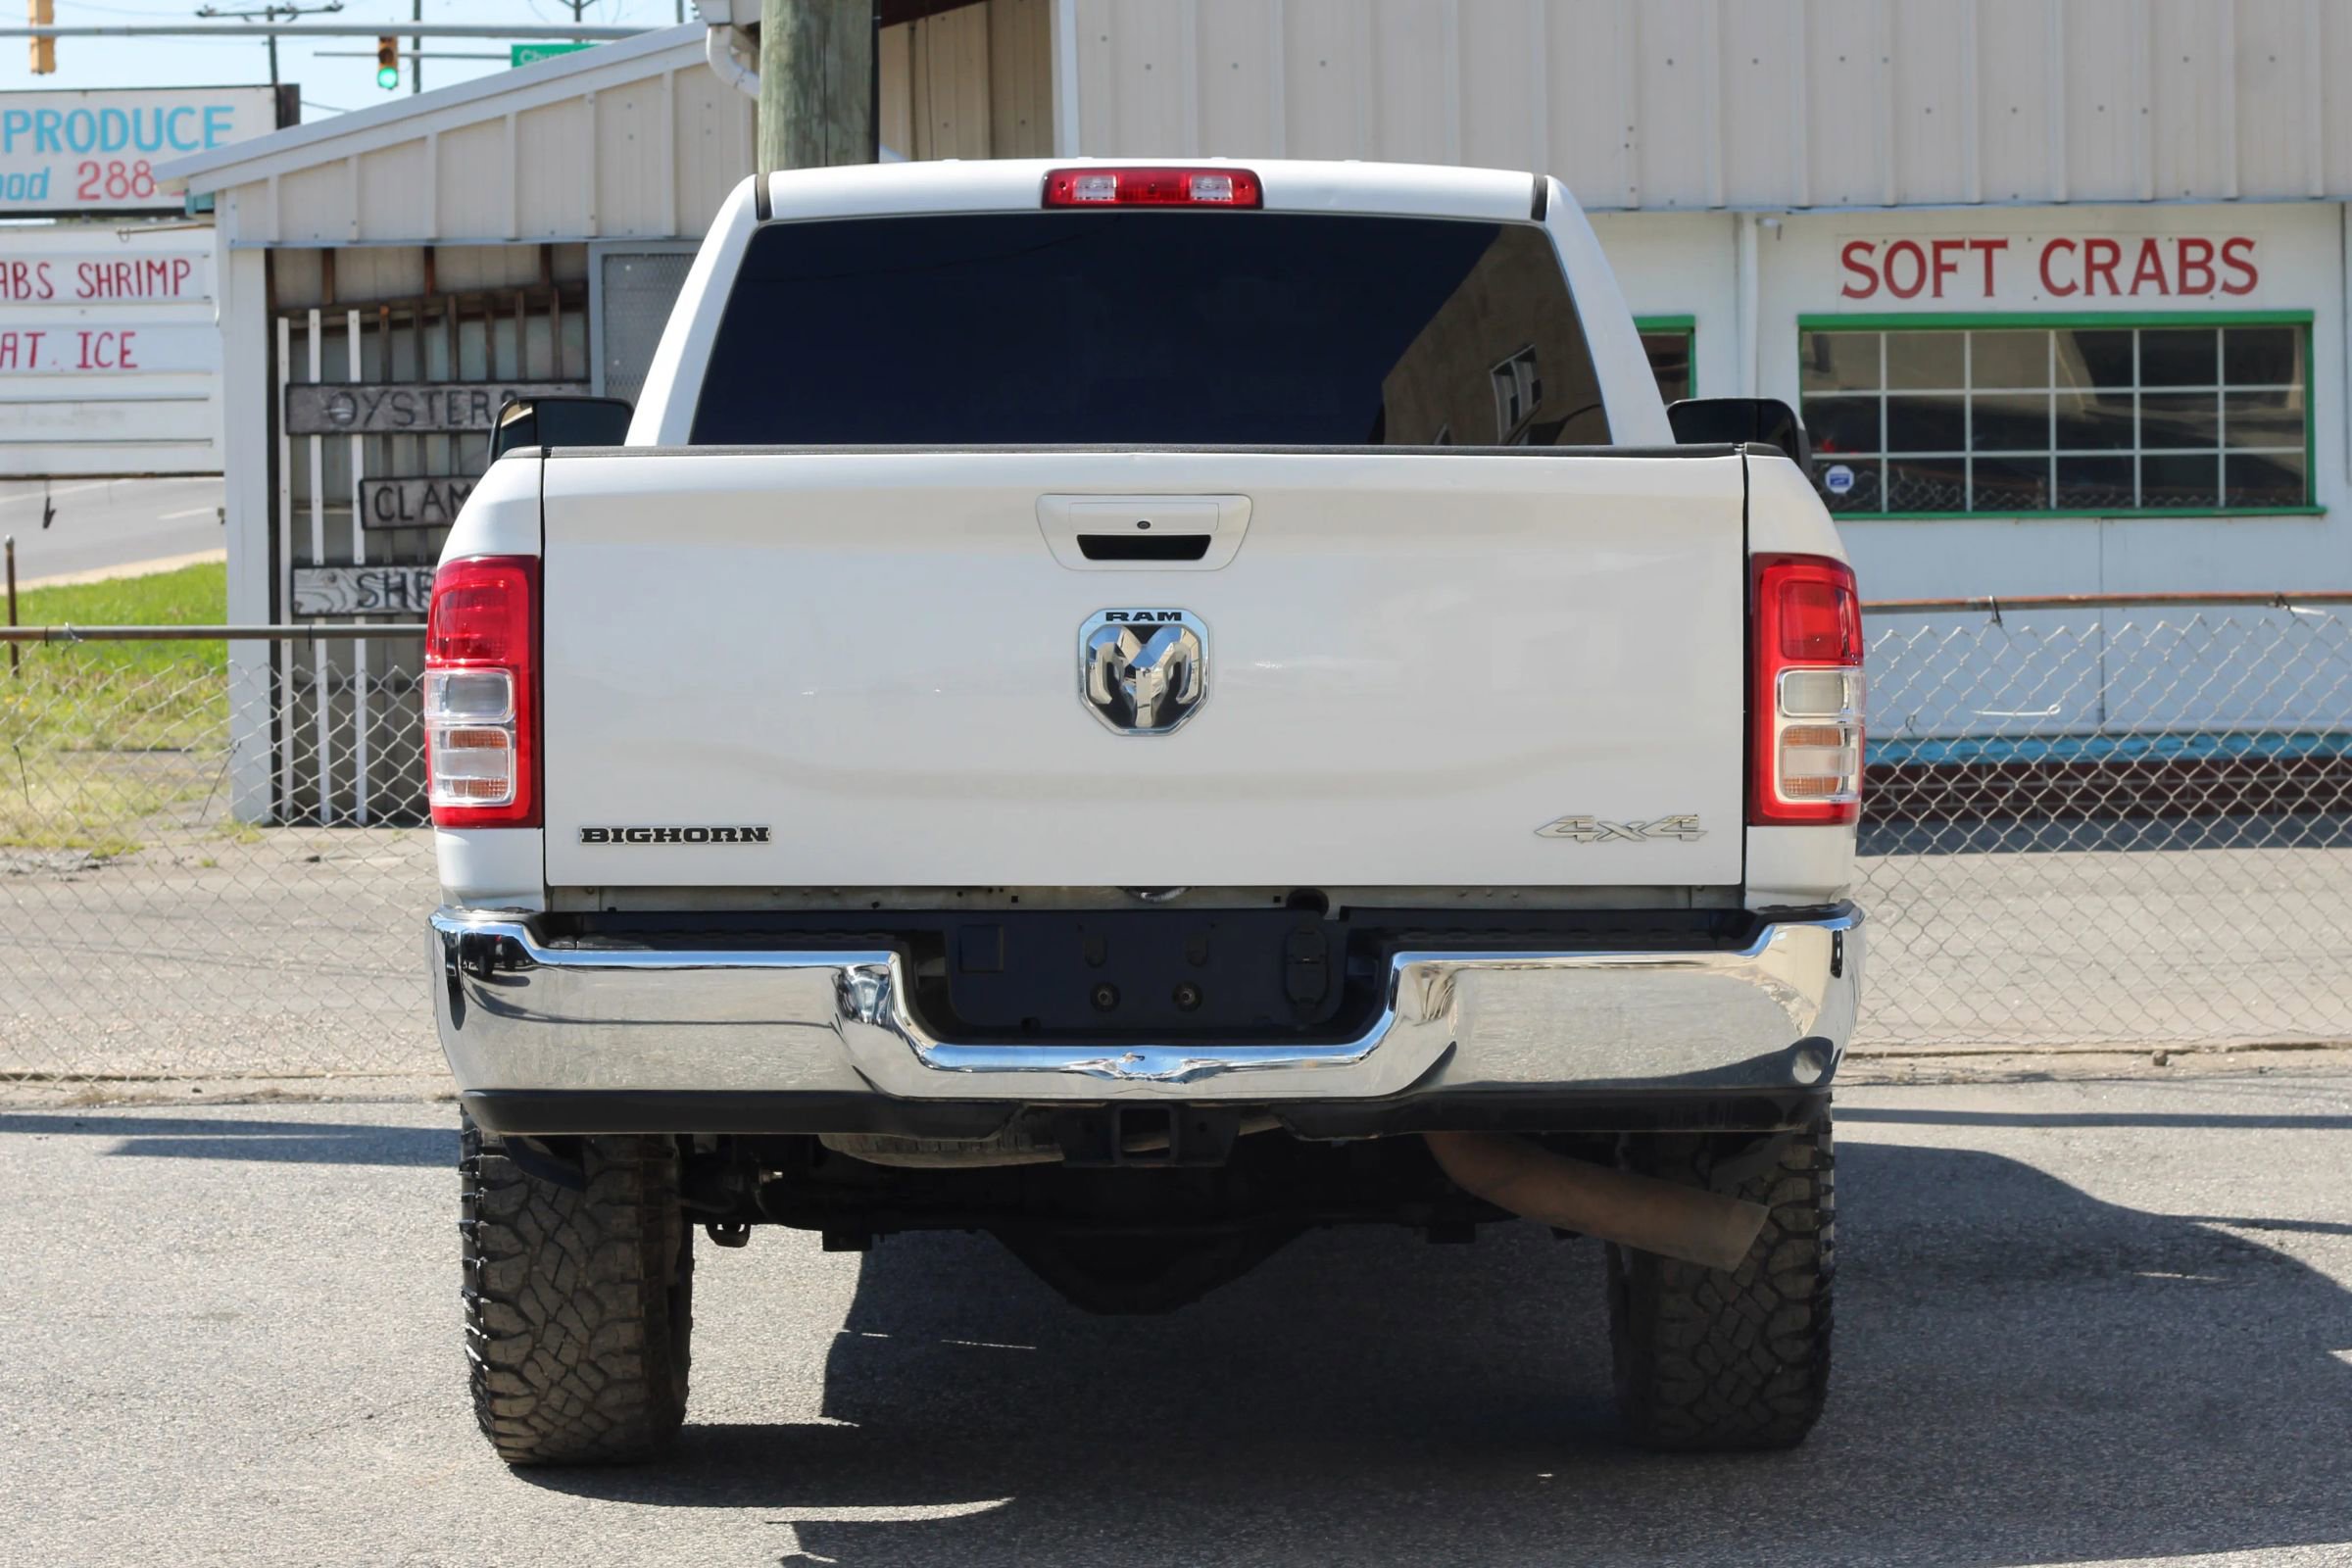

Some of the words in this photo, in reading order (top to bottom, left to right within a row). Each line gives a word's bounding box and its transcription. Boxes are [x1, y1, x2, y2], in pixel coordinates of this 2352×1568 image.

[2, 105, 235, 154] PRODUCE
[0, 166, 51, 202] od
[76, 259, 191, 299] SHRIMP
[1841, 239, 2009, 299] SOFT
[2039, 236, 2259, 298] CRABS
[75, 331, 138, 369] ICE
[327, 389, 518, 427] OYSTER
[1105, 612, 1182, 622] RAM
[580, 826, 770, 844] BIGHORN
